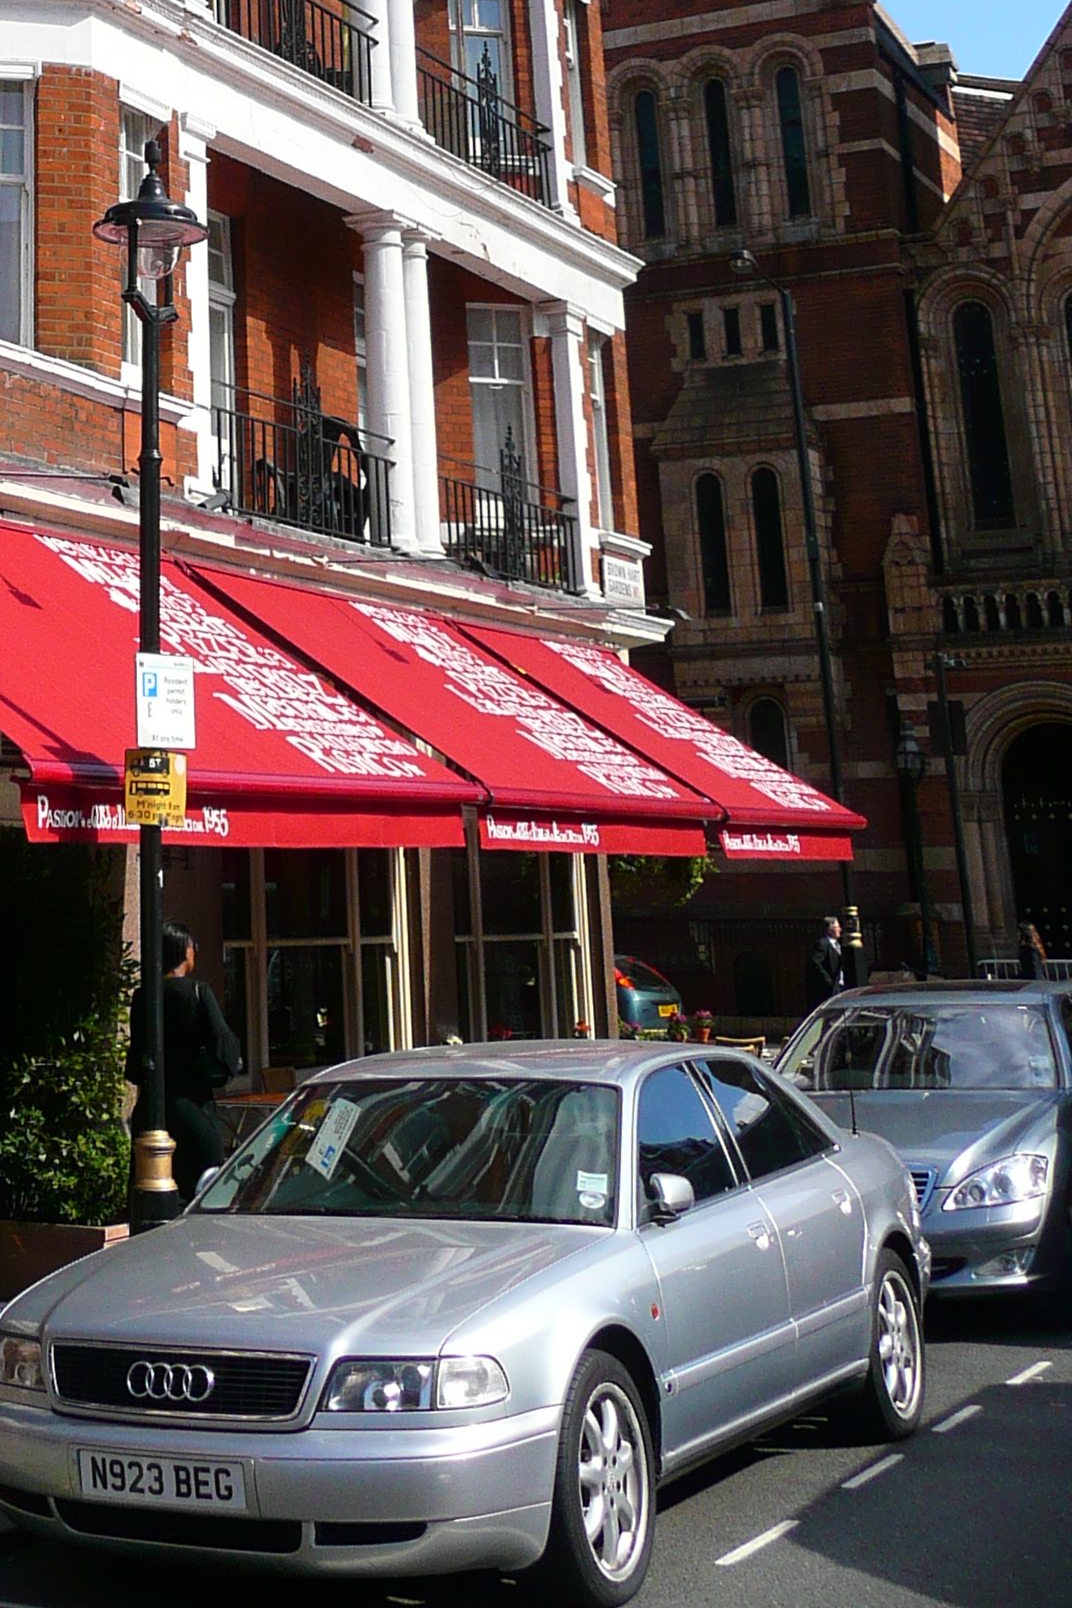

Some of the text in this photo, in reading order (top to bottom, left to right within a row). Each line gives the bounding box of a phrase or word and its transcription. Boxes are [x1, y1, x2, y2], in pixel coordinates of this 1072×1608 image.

[608, 562, 640, 583] BROWN HART
[609, 579, 632, 597] GARDENS
[164, 676, 188, 686] Resident
[167, 689, 185, 697] permit
[91, 1456, 233, 1501] N923 BEG
